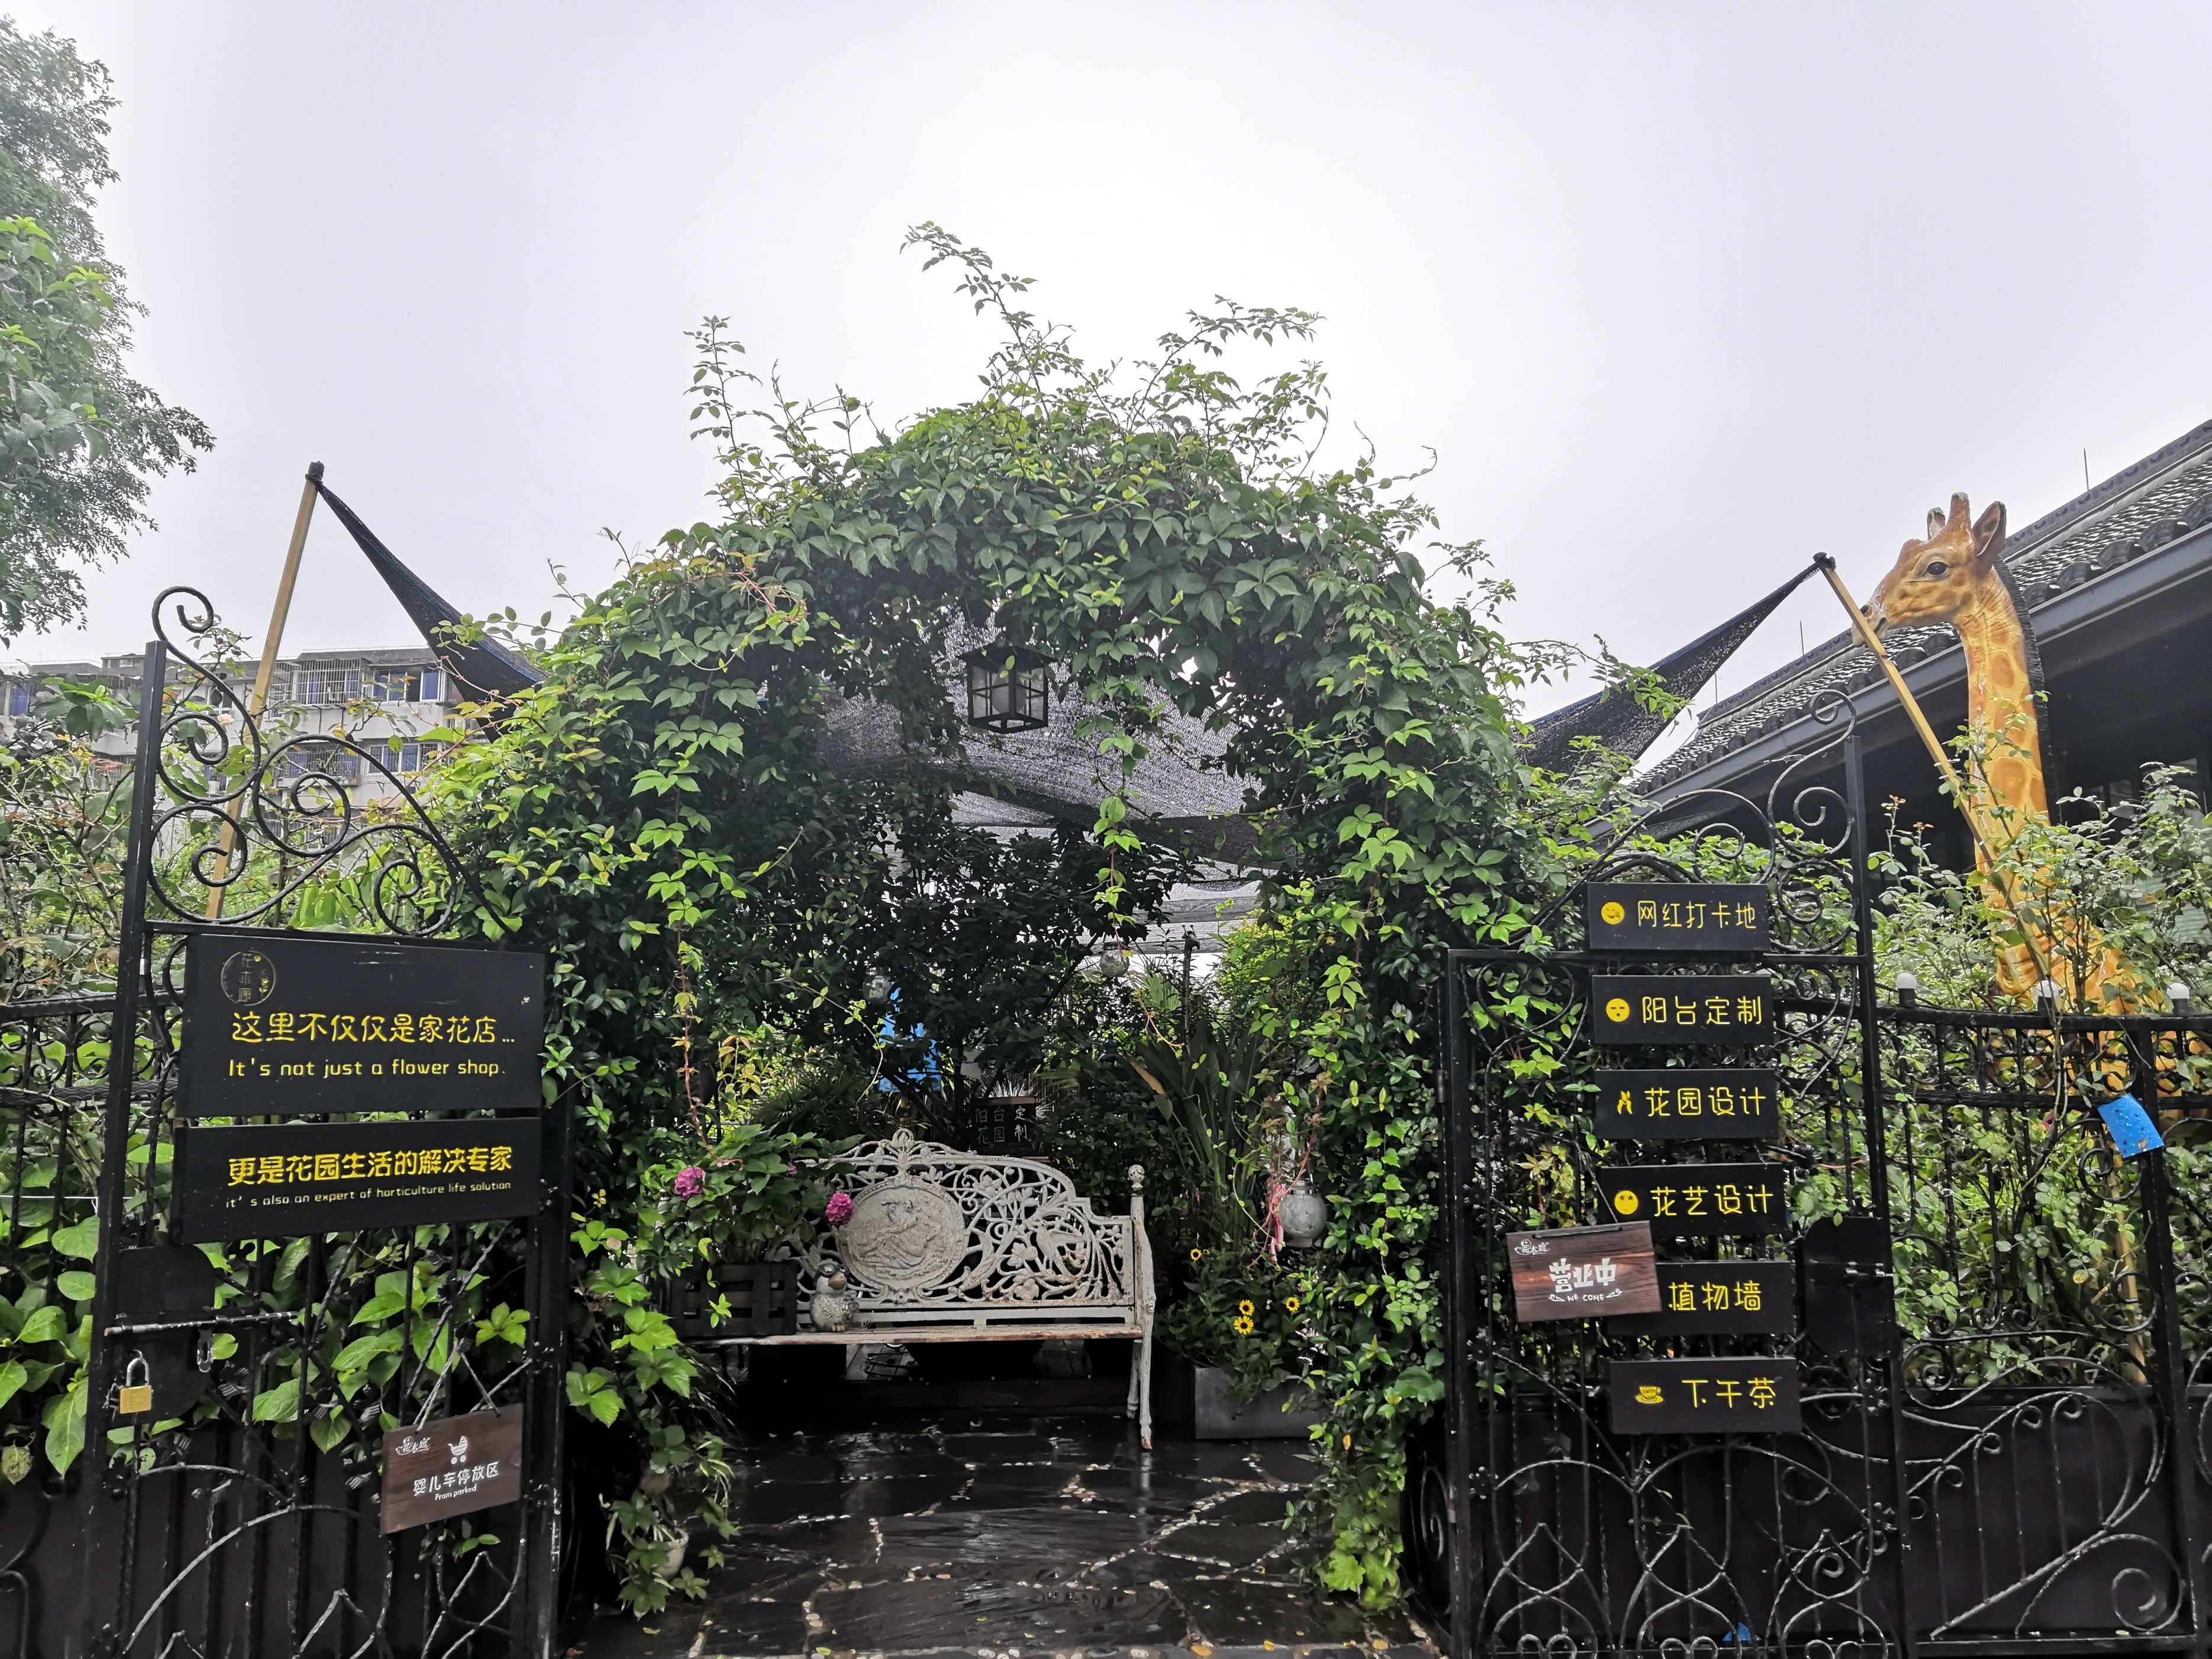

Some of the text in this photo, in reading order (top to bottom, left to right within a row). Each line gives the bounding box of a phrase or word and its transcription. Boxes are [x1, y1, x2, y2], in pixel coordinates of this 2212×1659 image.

[1638, 899, 1757, 929] 网红打卡地
[1642, 996, 1762, 1025] 阳台定制
[229, 1057, 506, 1079] It's not just a flower shop.
[1644, 1087, 1767, 1116] 花园设计
[228, 1146, 512, 1186] 更是花园生活的解决专家
[263, 1195, 289, 1205] also
[295, 1194, 310, 1203] an
[314, 1190, 354, 1203] expert
[360, 1188, 372, 1199] of
[376, 1186, 444, 1198] horticulture
[448, 1183, 466, 1193] life
[470, 1182, 511, 1192] solution
[1650, 1184, 1774, 1216] 花艺设计
[1549, 1258, 1617, 1293] 营业中
[1668, 1280, 1761, 1312] 植物墙
[1681, 1377, 1776, 1409] 下午茶
[412, 1461, 500, 1496] 婴儿车停放区
[435, 1484, 477, 1500] Pram parked
